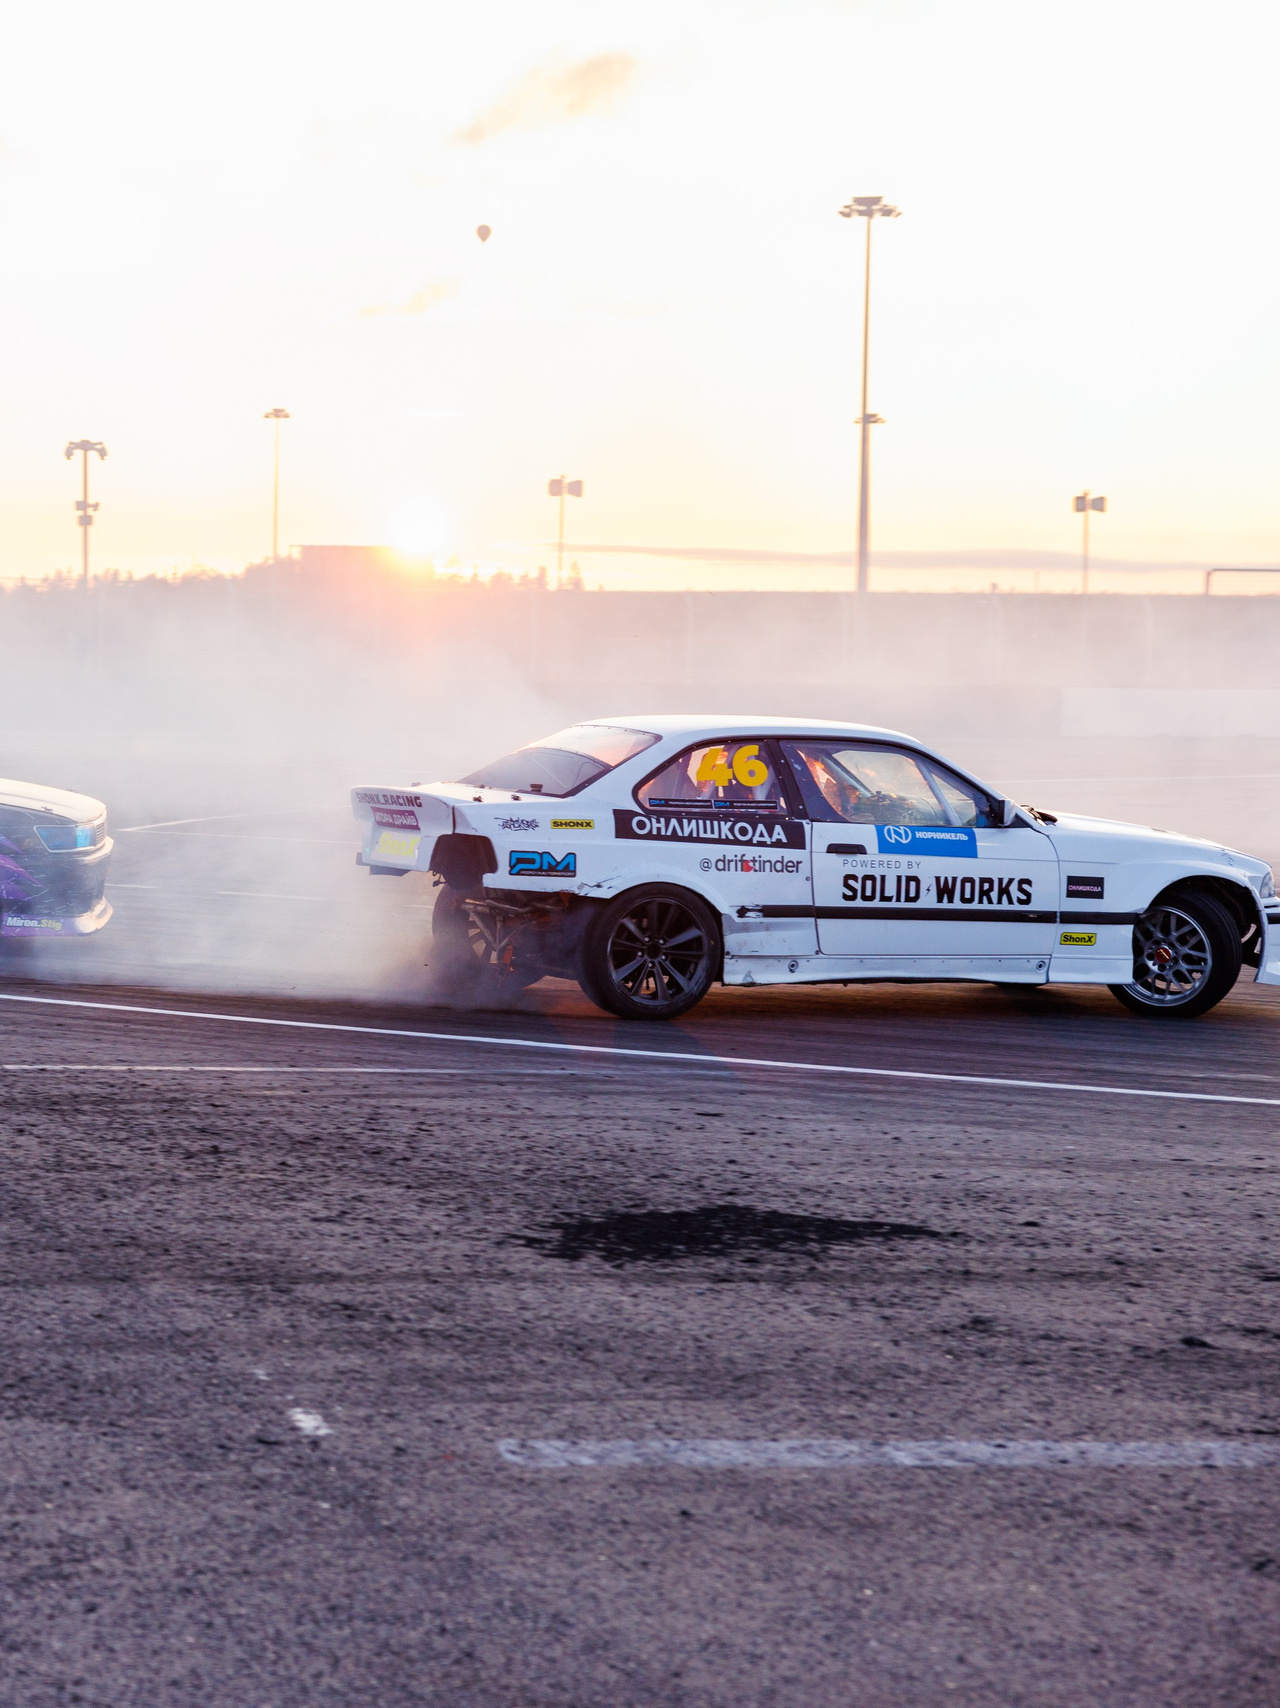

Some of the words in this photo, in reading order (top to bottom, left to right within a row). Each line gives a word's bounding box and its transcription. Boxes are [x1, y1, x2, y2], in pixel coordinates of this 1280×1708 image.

[696, 745, 768, 787] 46
[552, 820, 593, 828] SHONX
[631, 816, 788, 845] ОНЛИШКОДА
[915, 831, 969, 841] НОРНИКЕЛЬ
[509, 851, 575, 874] PM
[843, 859, 902, 869] POWERED
[907, 860, 922, 870] BY
[842, 873, 921, 903] SOLID
[934, 875, 1033, 906] WORKS
[1062, 934, 1094, 943] ShonX
